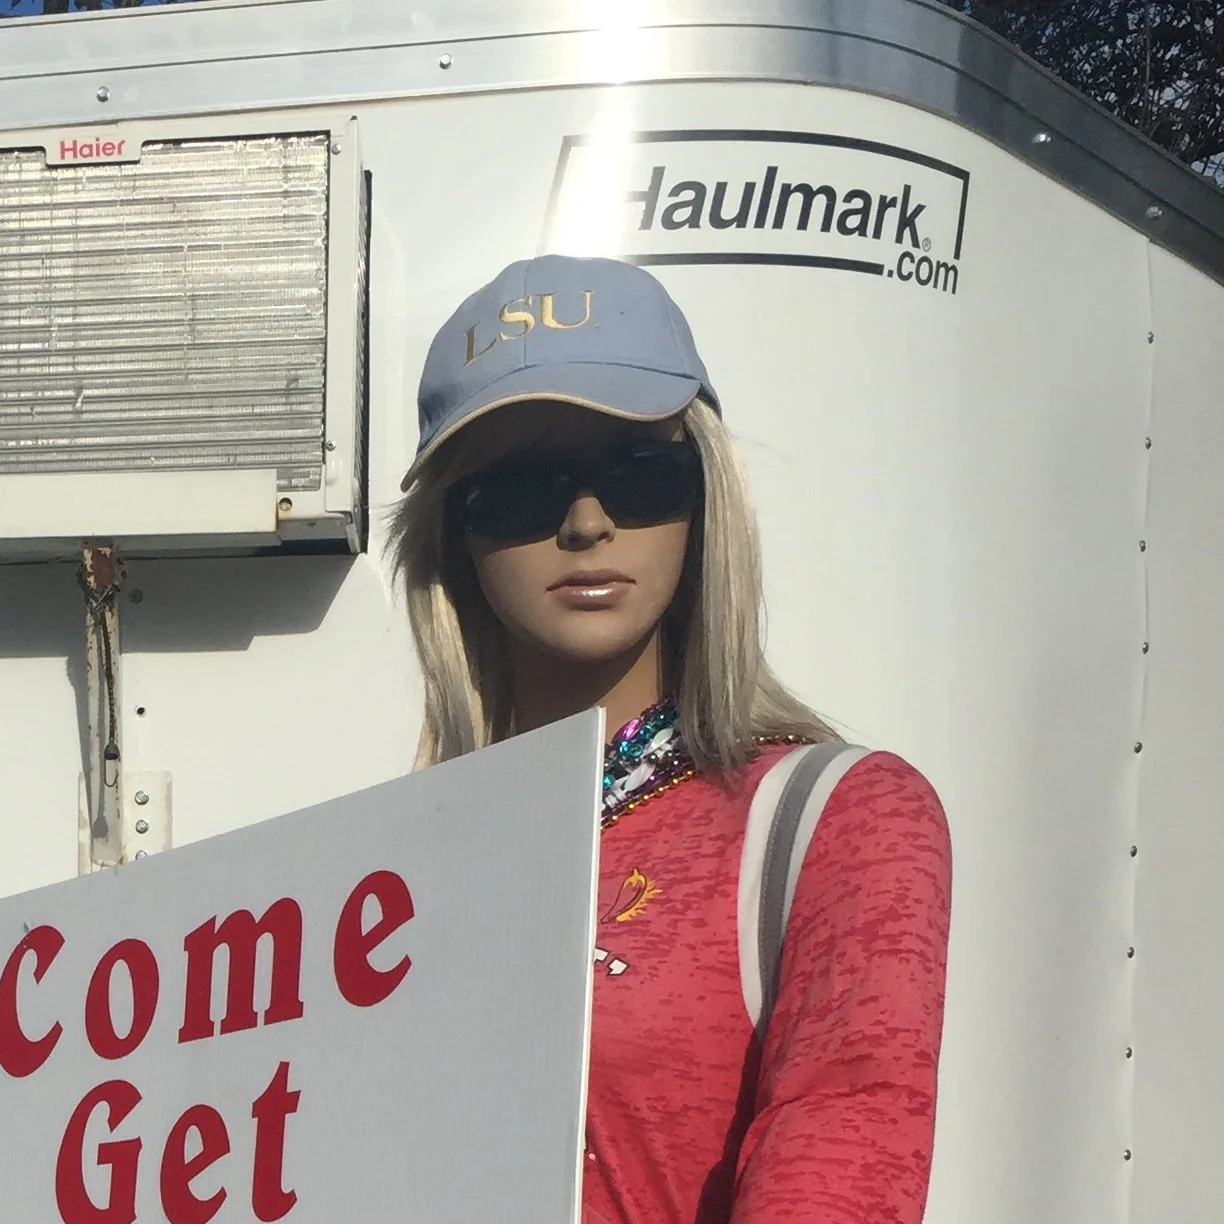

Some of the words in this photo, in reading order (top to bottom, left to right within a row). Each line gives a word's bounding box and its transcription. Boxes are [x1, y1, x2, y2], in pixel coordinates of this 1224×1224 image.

[59, 136, 126, 160] Haier
[622, 165, 929, 251] Haulmark
[885, 249, 960, 296] .com
[463, 288, 596, 368] LSU
